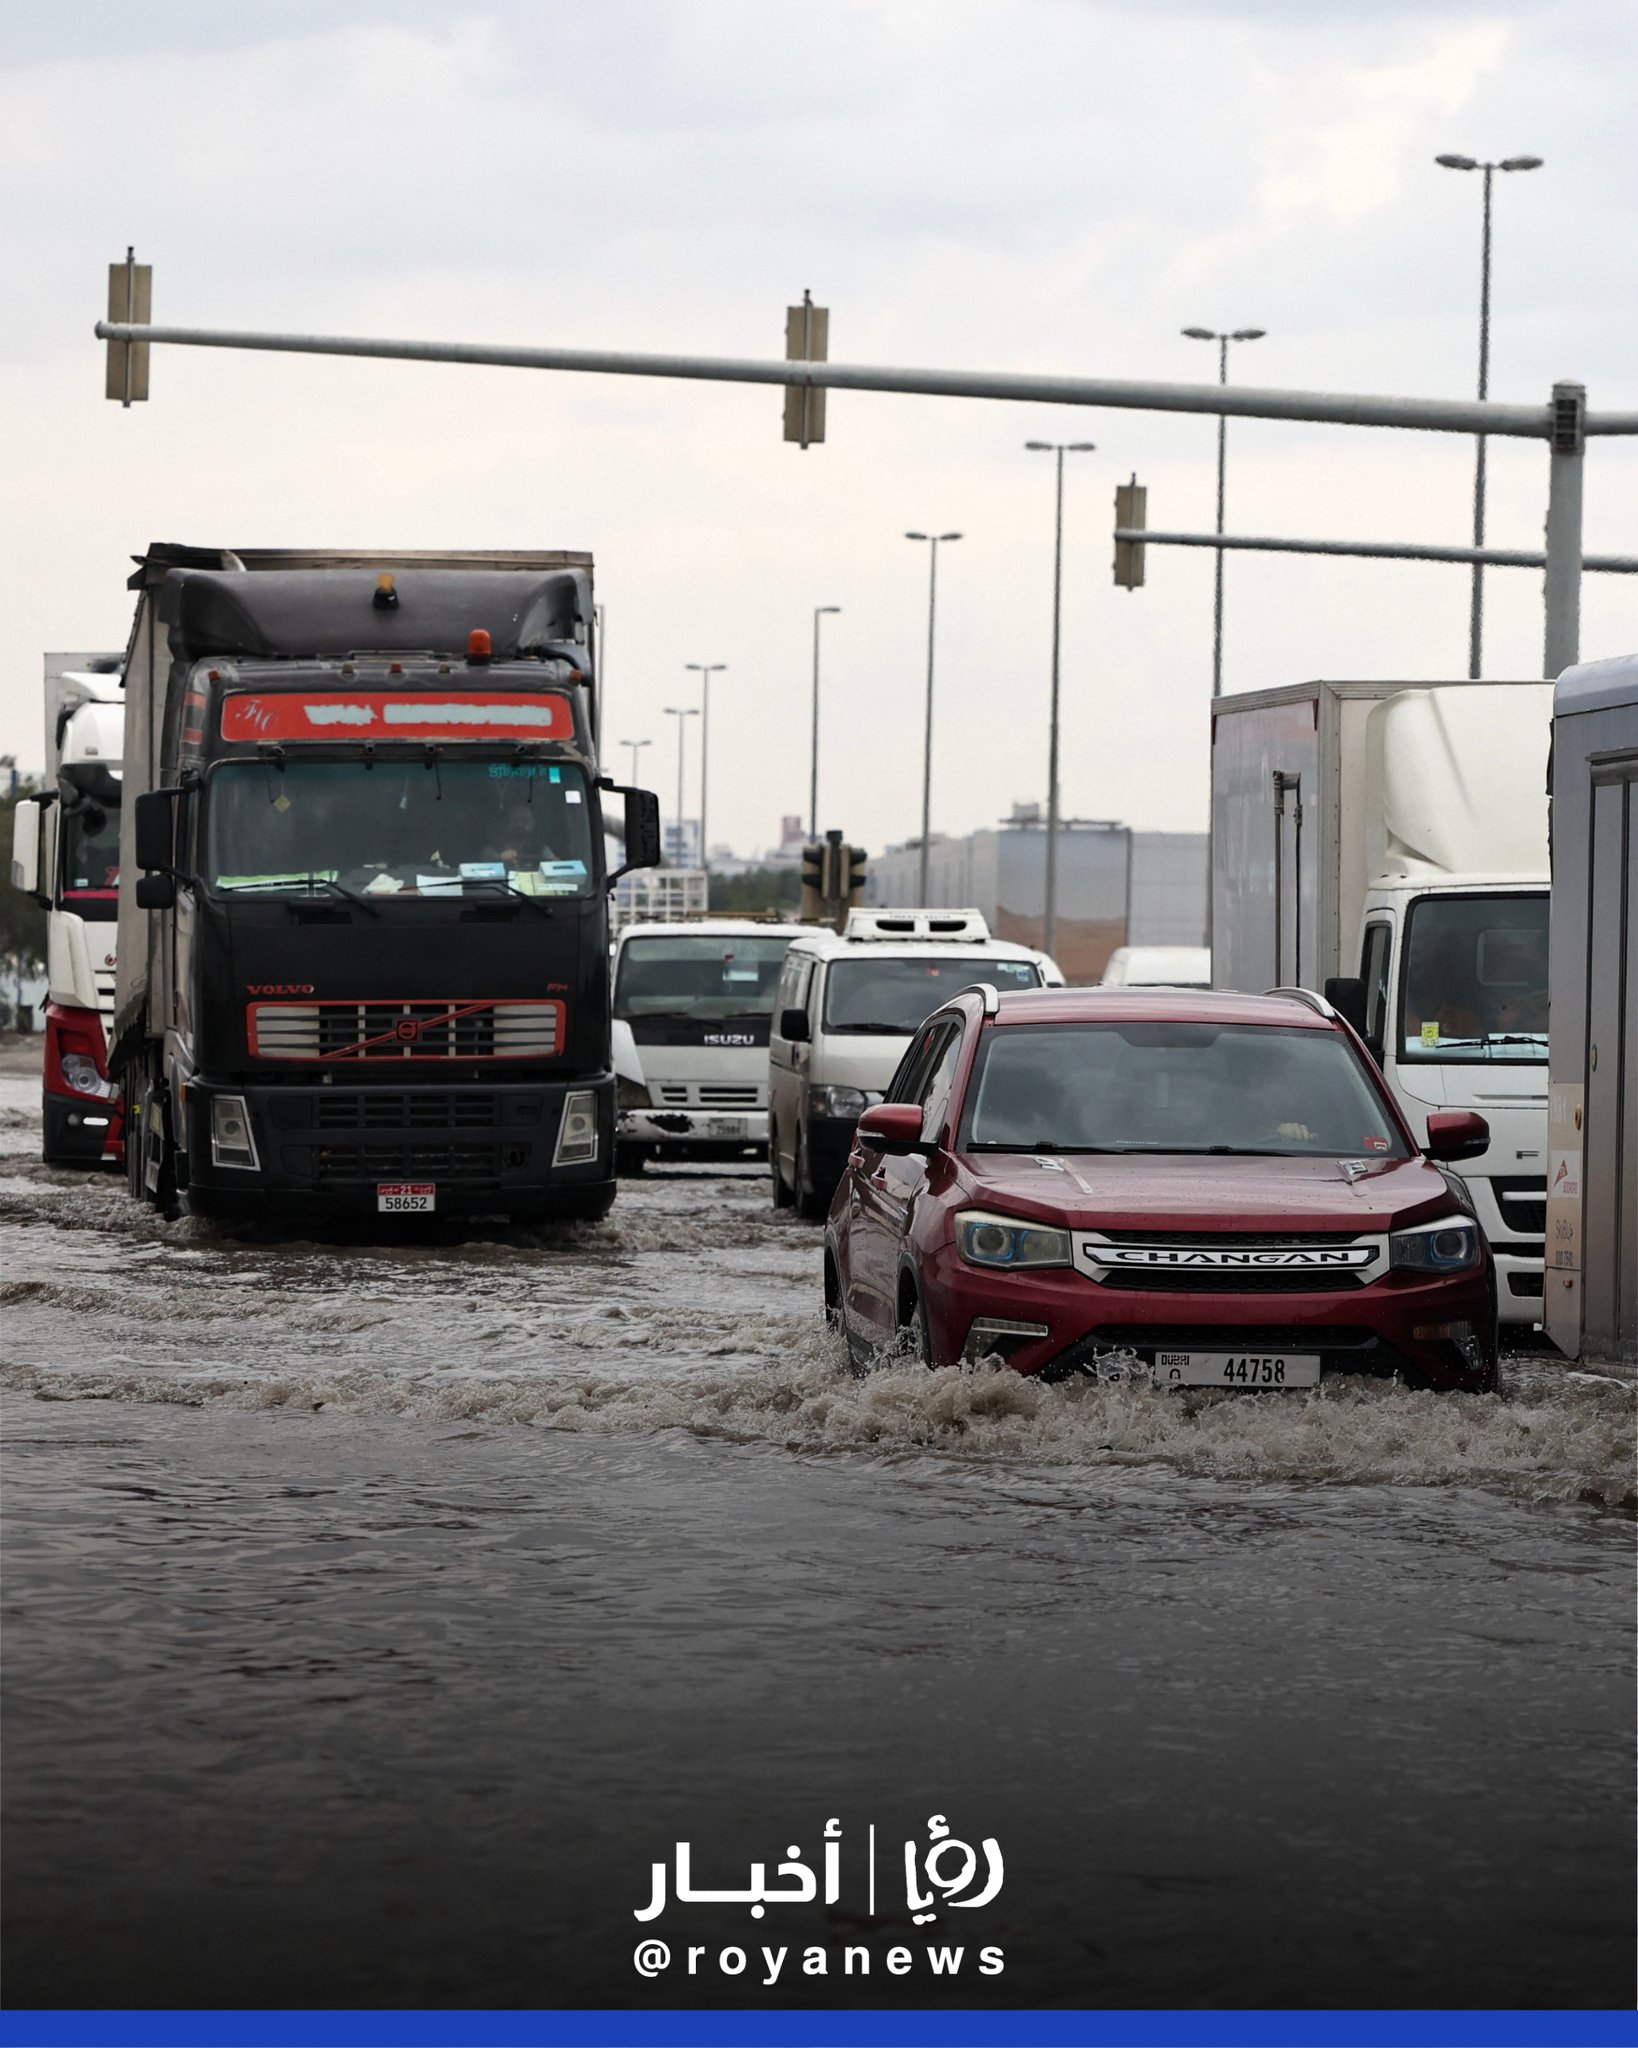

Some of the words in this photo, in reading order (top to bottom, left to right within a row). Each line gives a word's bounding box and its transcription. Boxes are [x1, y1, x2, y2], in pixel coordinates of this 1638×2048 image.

[246, 984, 314, 995] VOLVO
[704, 1034, 754, 1045] ISUZU
[400, 1185, 412, 1195] 21
[385, 1197, 427, 1210] 58652
[1116, 1251, 1349, 1264] CHANGAN
[1223, 1358, 1285, 1384] 44758
